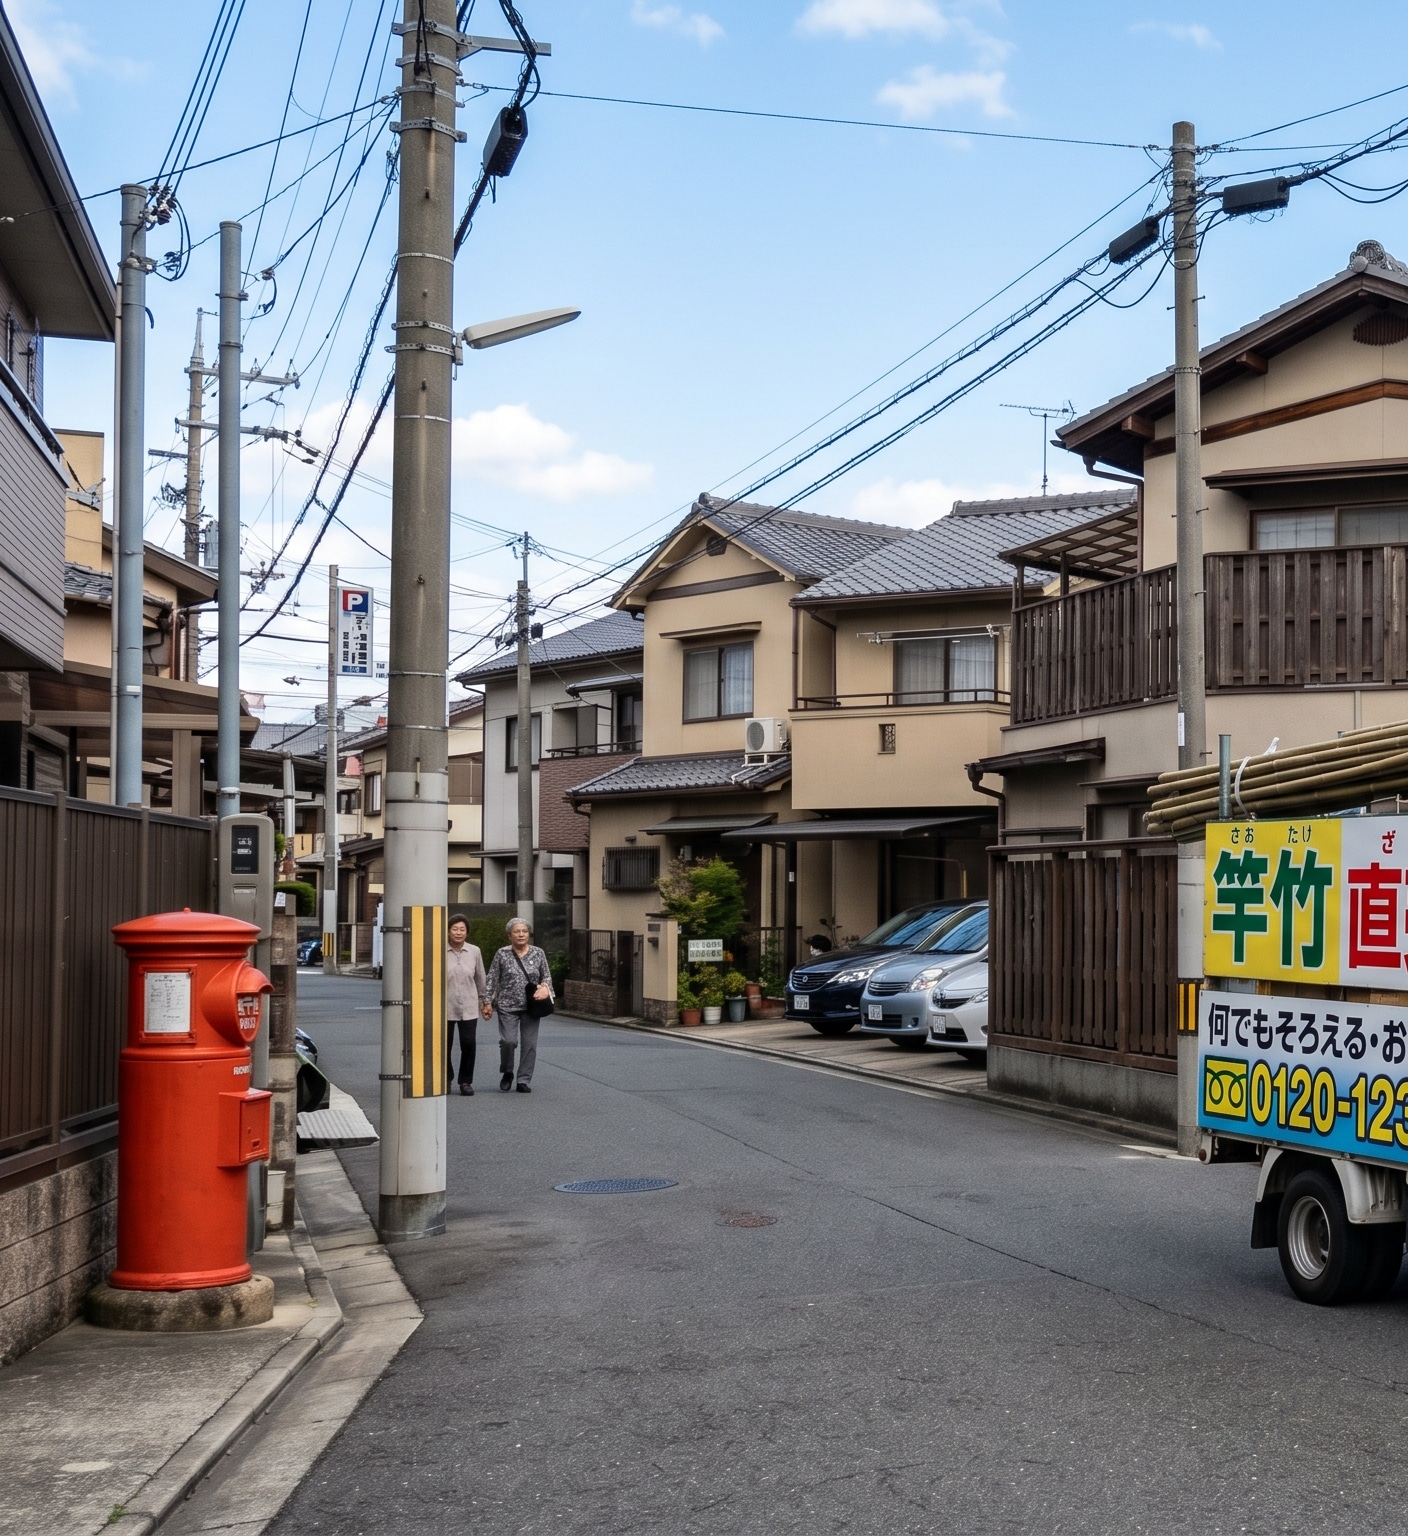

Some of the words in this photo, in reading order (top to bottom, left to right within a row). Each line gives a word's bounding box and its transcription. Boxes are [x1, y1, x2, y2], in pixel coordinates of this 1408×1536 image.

[1231, 827, 1254, 844] さお
[1288, 824, 1312, 844] たけ
[1212, 849, 1333, 968] 竿竹
